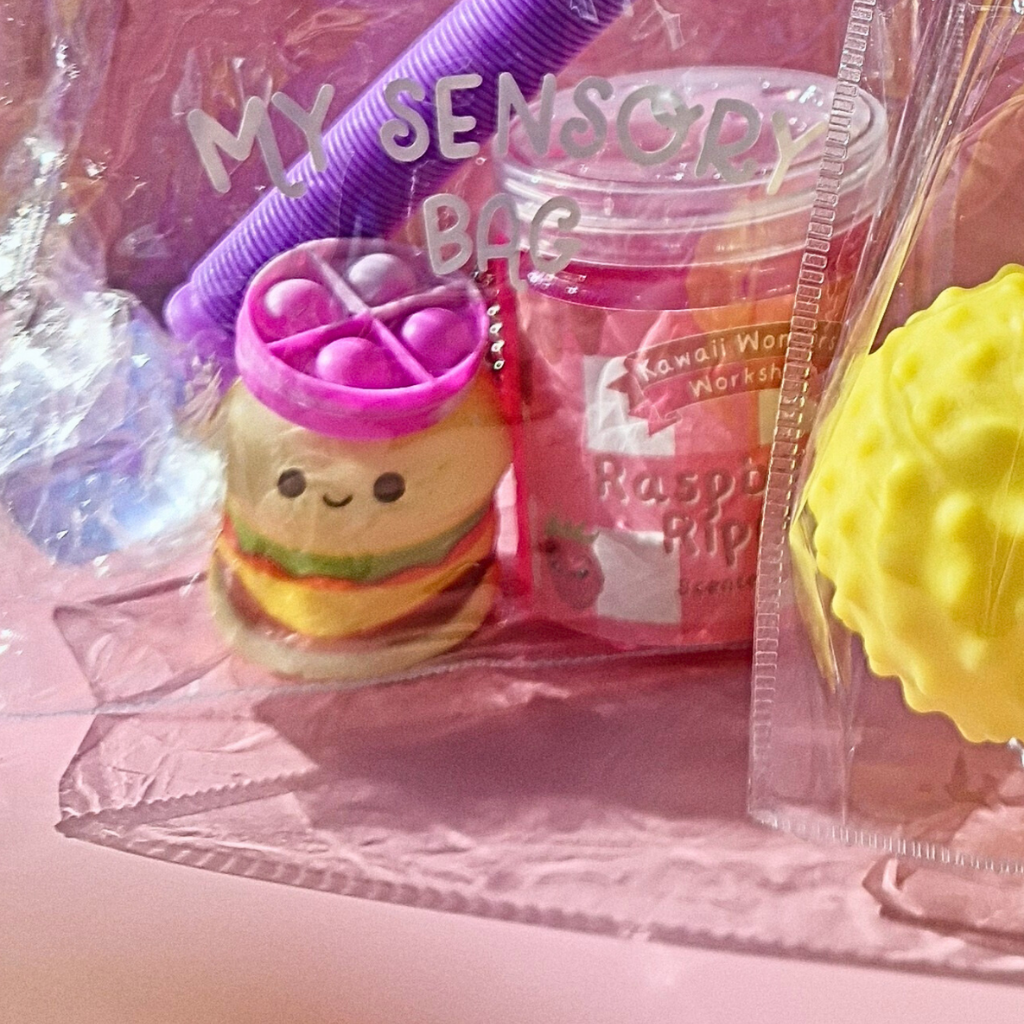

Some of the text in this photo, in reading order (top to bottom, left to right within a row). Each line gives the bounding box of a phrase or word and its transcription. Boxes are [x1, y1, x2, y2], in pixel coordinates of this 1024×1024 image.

[186, 70, 828, 199] MY SENSORY
[423, 192, 583, 292] BAG
[642, 338, 727, 381] Kawaii
[689, 362, 784, 398] Worksh
[597, 457, 767, 523] Raspb
[664, 512, 752, 568] Rip
